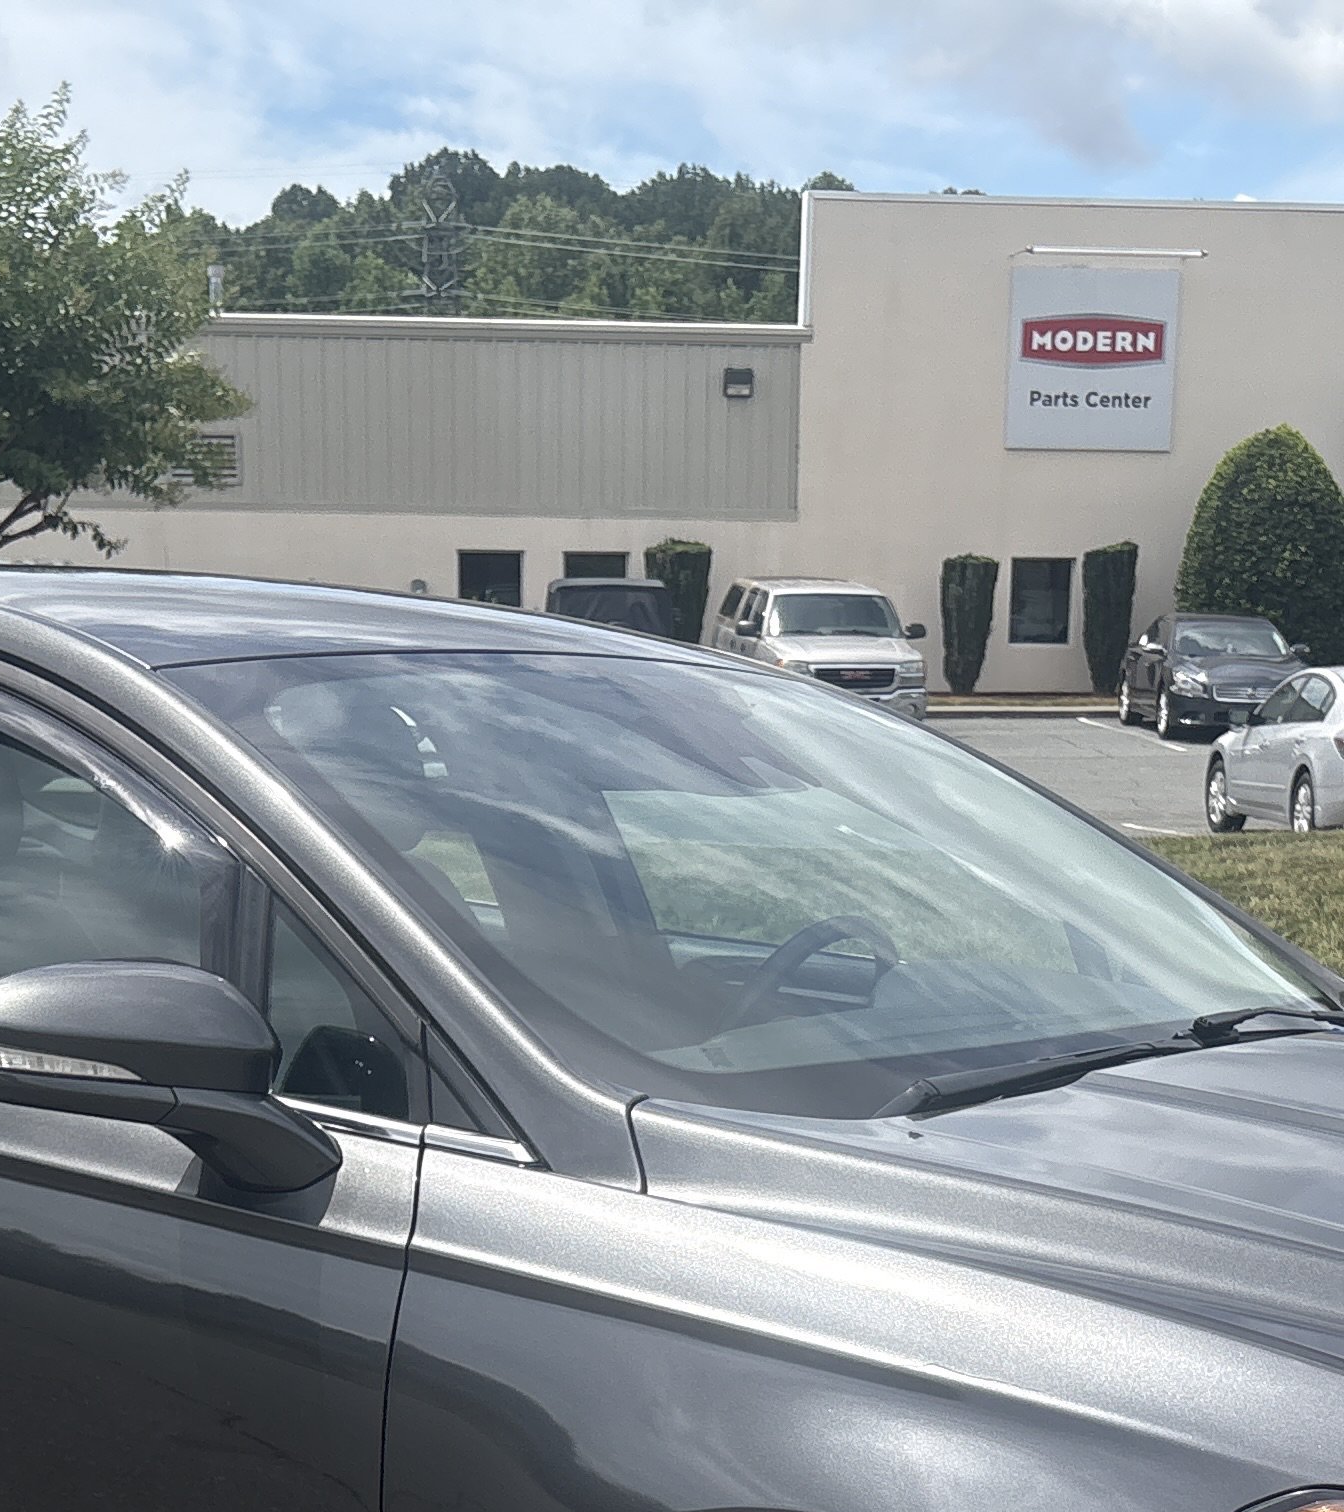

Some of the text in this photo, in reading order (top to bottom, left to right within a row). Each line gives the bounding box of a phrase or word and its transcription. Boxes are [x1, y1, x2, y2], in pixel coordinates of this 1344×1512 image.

[1030, 330, 1156, 353] MODERN
[1029, 390, 1152, 409] Parts Center
